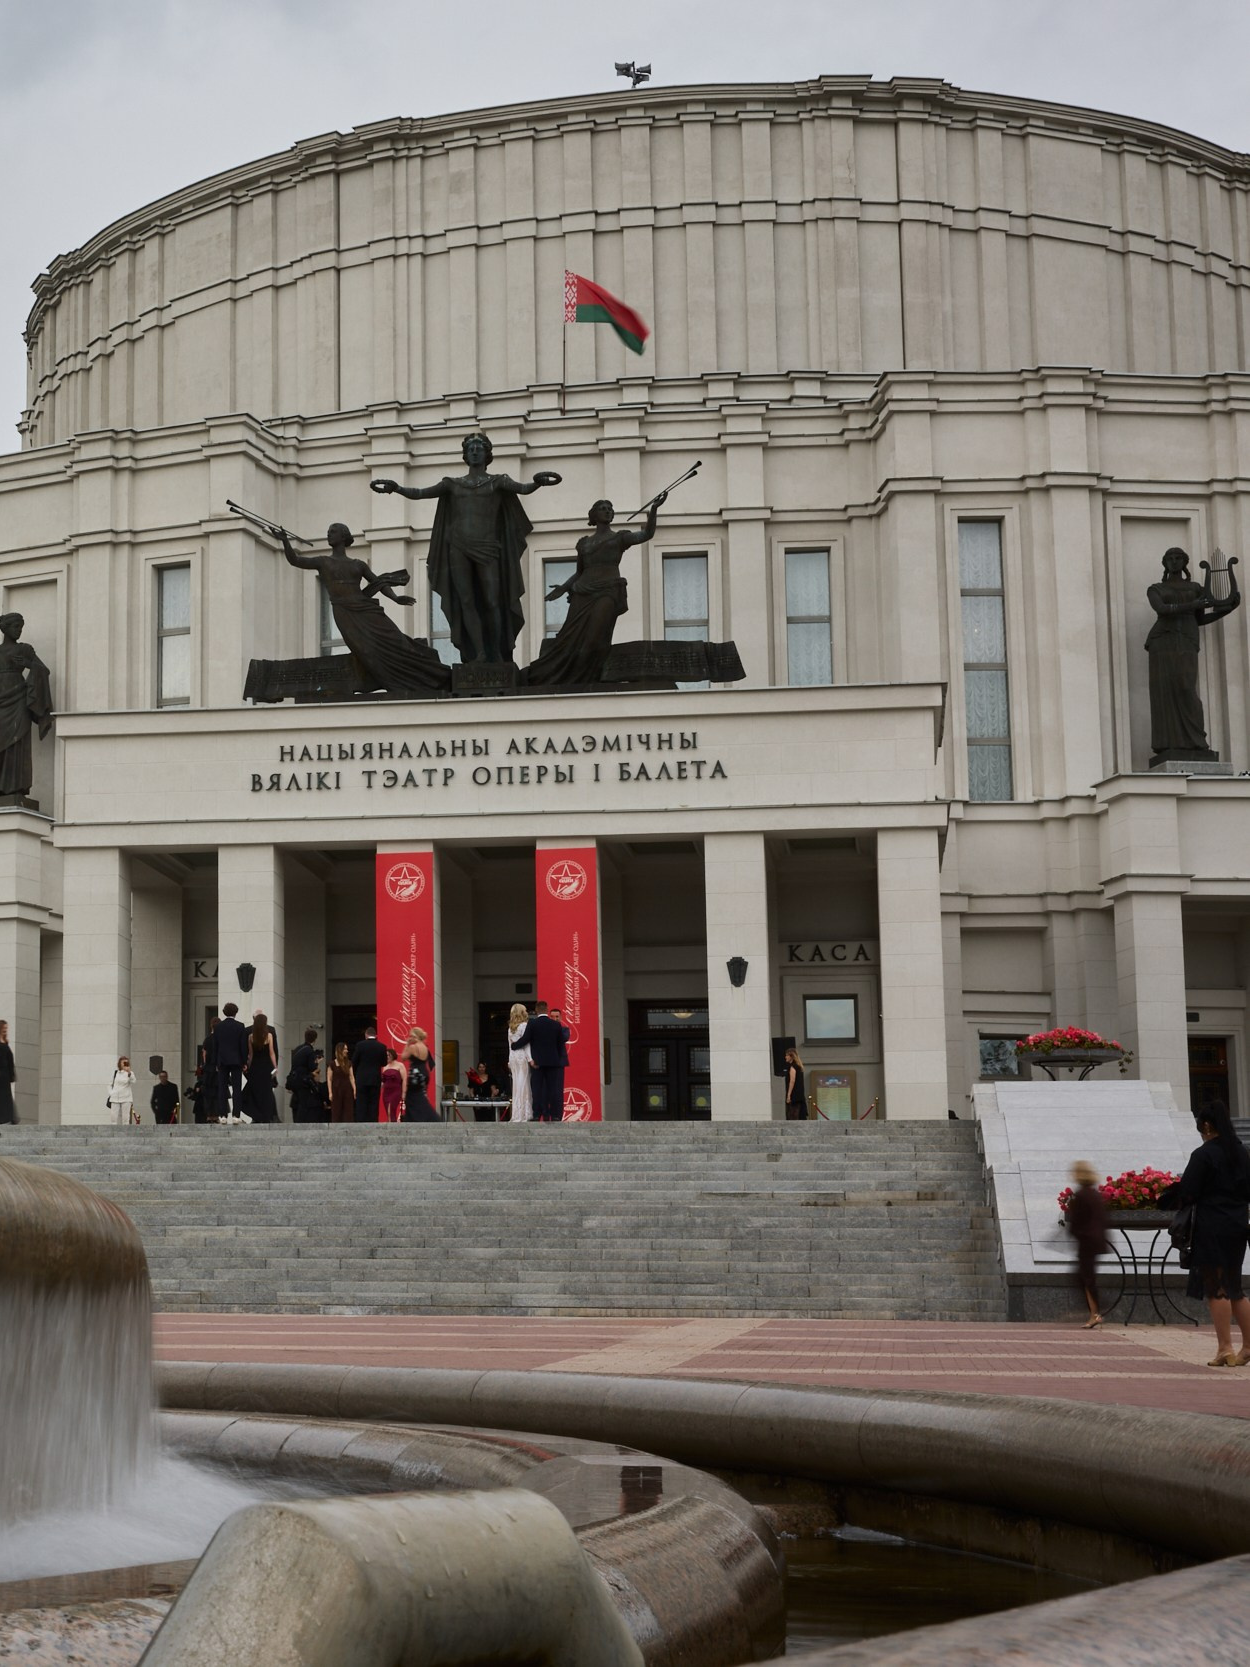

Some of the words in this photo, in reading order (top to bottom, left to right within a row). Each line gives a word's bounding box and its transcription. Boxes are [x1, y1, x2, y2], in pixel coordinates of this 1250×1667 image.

[279, 739, 490, 762] НАЦЫЯНАЛЬНЫ
[505, 732, 698, 754] АКАДЭМІЧНЫ
[250, 771, 341, 792] ВЯЛІКІ
[361, 768, 455, 789] ТЭАТР
[472, 764, 575, 785] ОПЕРЫ
[593, 763, 600, 782] І
[618, 759, 728, 782] БАЛЕТА
[787, 943, 871, 962] КАСА
[386, 962, 426, 1046] Ceremony
